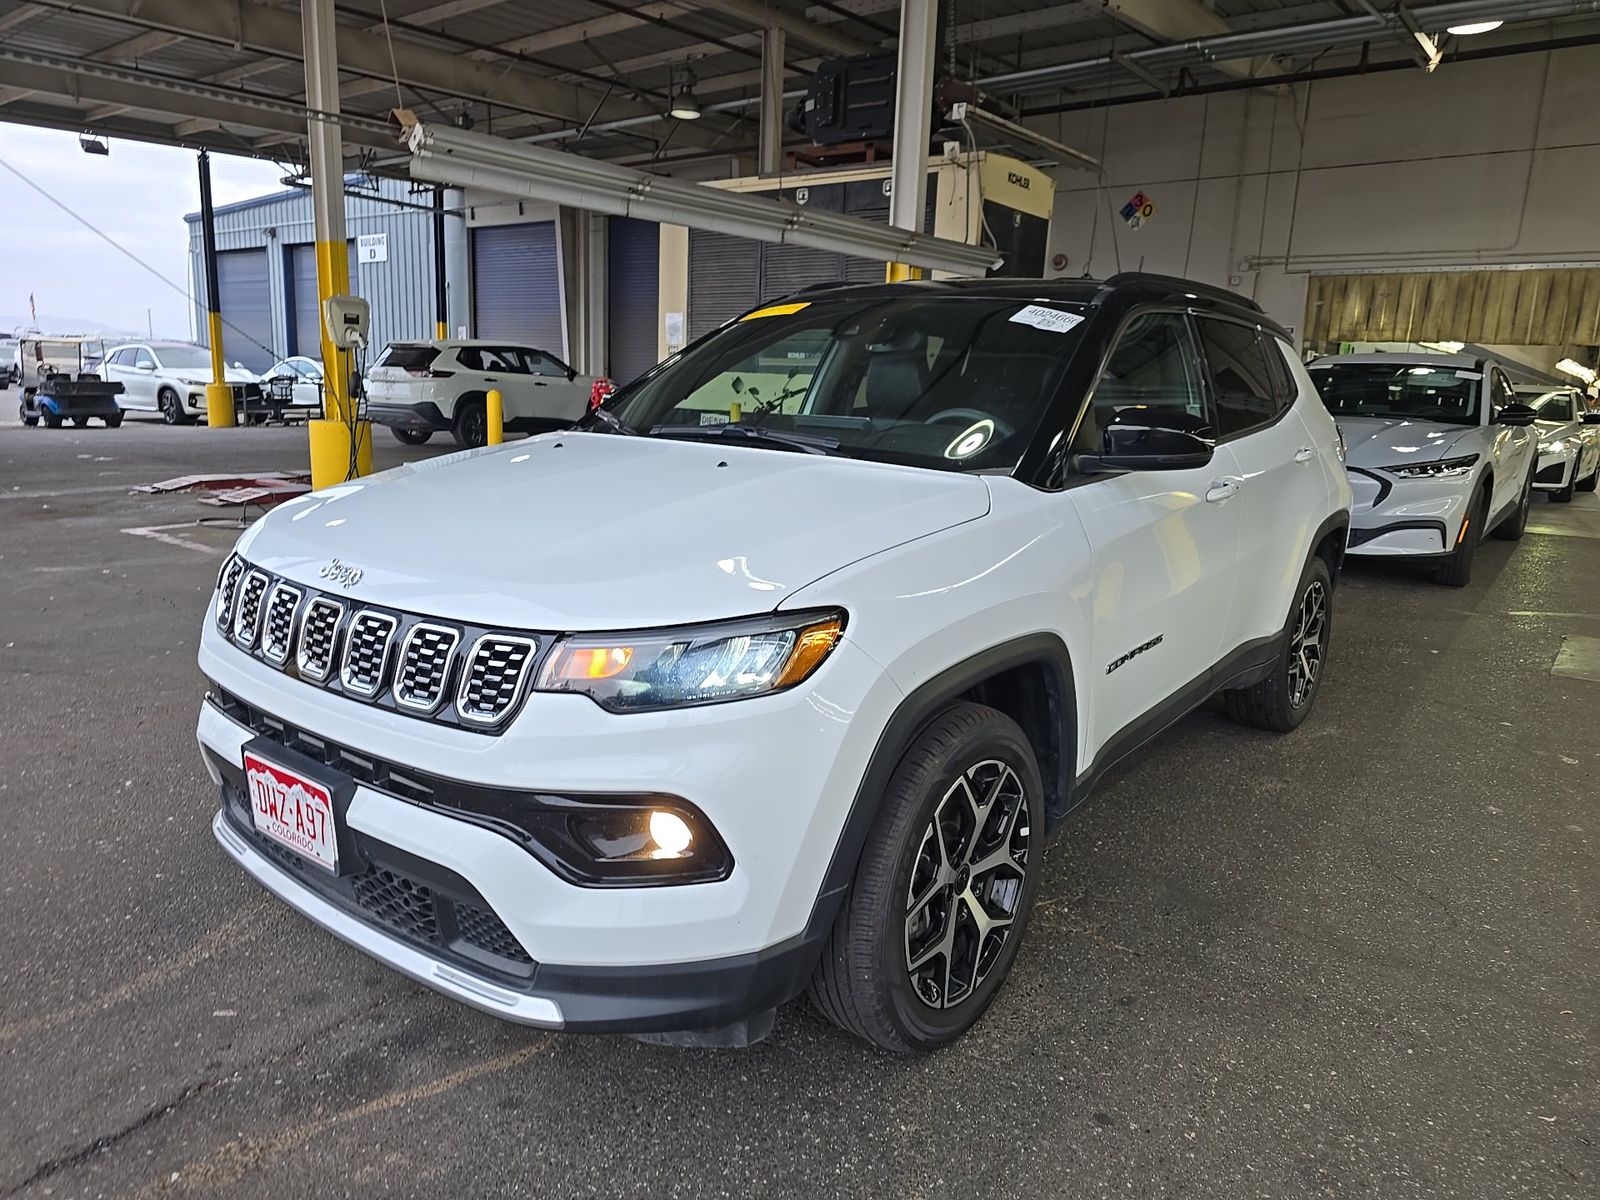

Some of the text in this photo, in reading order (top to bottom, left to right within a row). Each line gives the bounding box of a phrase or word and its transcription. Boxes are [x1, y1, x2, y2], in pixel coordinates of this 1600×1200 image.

[1008, 172, 1030, 190] KOHLER
[1135, 194, 1144, 208] 3
[1143, 203, 1153, 217] 0
[369, 248, 376, 259] D
[320, 557, 364, 590] Jeep
[1105, 633, 1164, 675] COMPASS
[271, 821, 314, 852] COLORADO
